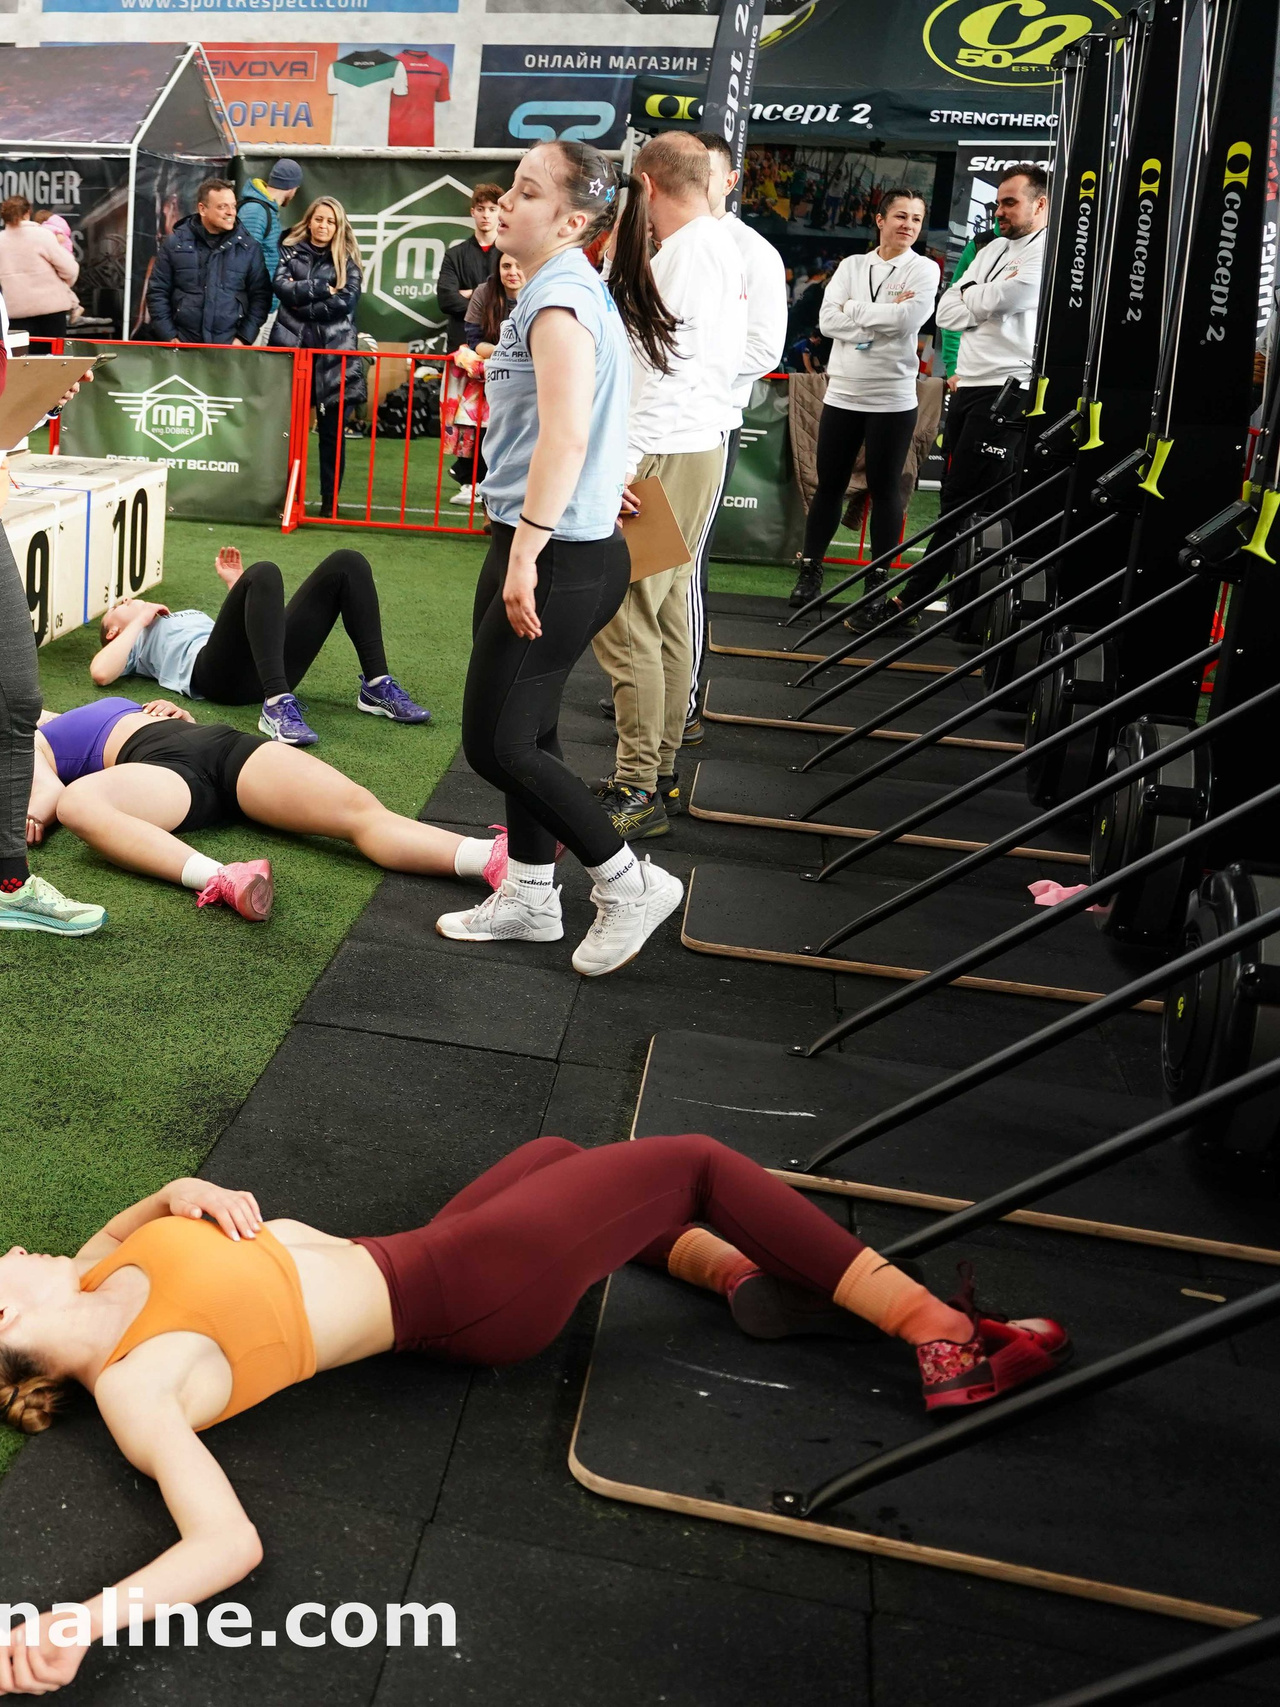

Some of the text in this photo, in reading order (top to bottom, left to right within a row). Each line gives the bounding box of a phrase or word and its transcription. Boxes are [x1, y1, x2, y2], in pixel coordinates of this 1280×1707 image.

[524, 51, 602, 70] ОНЛАЙН
[608, 56, 698, 72] МАГАЗИН
[743, 24, 759, 97] BIKEERG
[955, 48, 1014, 68] 50
[848, 103, 872, 125] 2
[929, 109, 1059, 127] STRENGTHERG
[1068, 202, 1092, 309] concept 2
[1126, 198, 1154, 323] concept 2
[1205, 191, 1242, 342] concept 2
[151, 427, 194, 436] eng.DOBREV
[152, 404, 195, 427] MA
[112, 487, 148, 598] 10
[26, 530, 50, 648] 9
